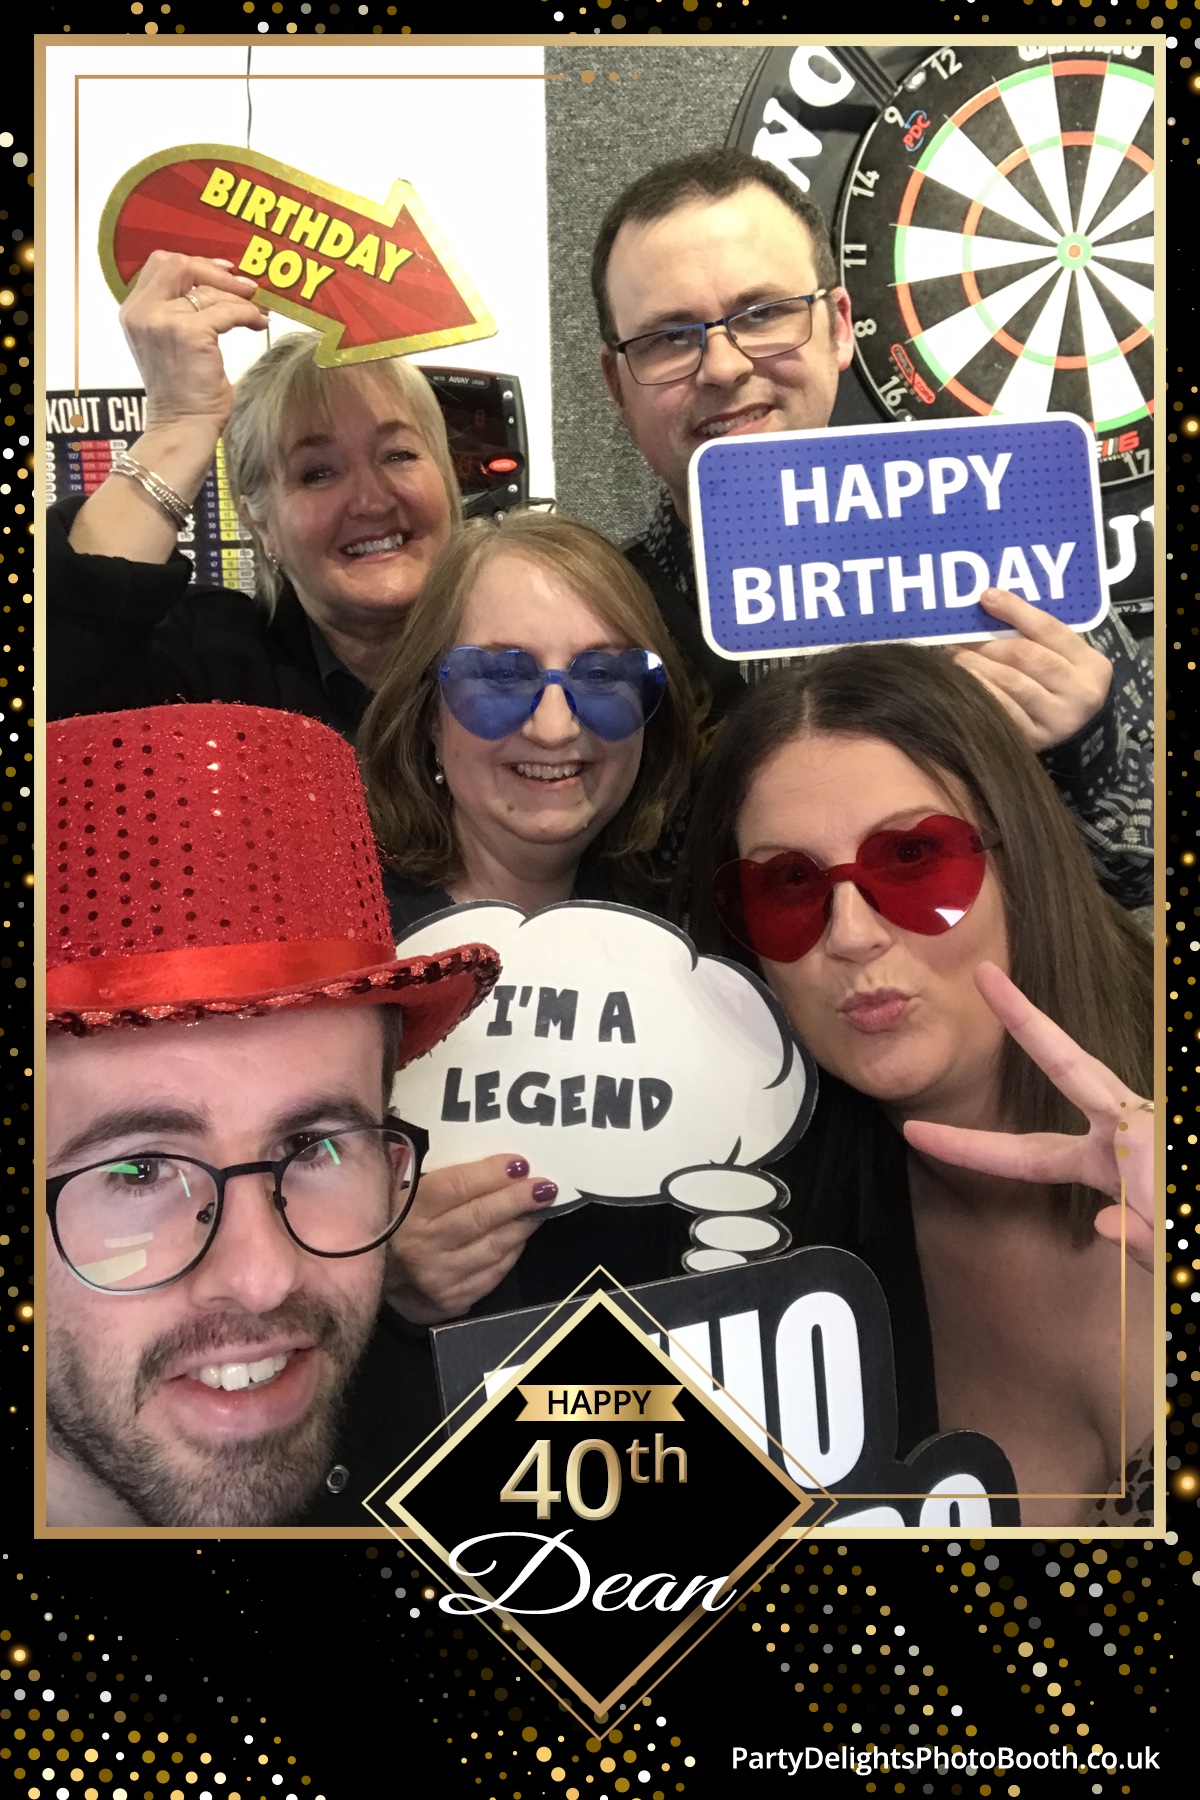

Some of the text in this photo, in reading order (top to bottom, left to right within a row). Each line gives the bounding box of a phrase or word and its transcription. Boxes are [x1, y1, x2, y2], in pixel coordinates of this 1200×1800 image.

[930, 49, 963, 80] 12
[884, 105, 905, 128] 9
[903, 114, 931, 148] PDC
[852, 170, 880, 197] 14
[200, 167, 414, 283] BIRTHDAY
[238, 235, 336, 300] BOY
[843, 243, 867, 268] 11
[854, 318, 877, 338] 8
[880, 376, 908, 407] 16
[1124, 448, 1151, 478] 17
[780, 452, 1012, 526] HAPPY
[731, 541, 1077, 625] BIRTHDAY
[486, 985, 637, 1044] I'M A
[440, 1067, 673, 1131] LEGEND
